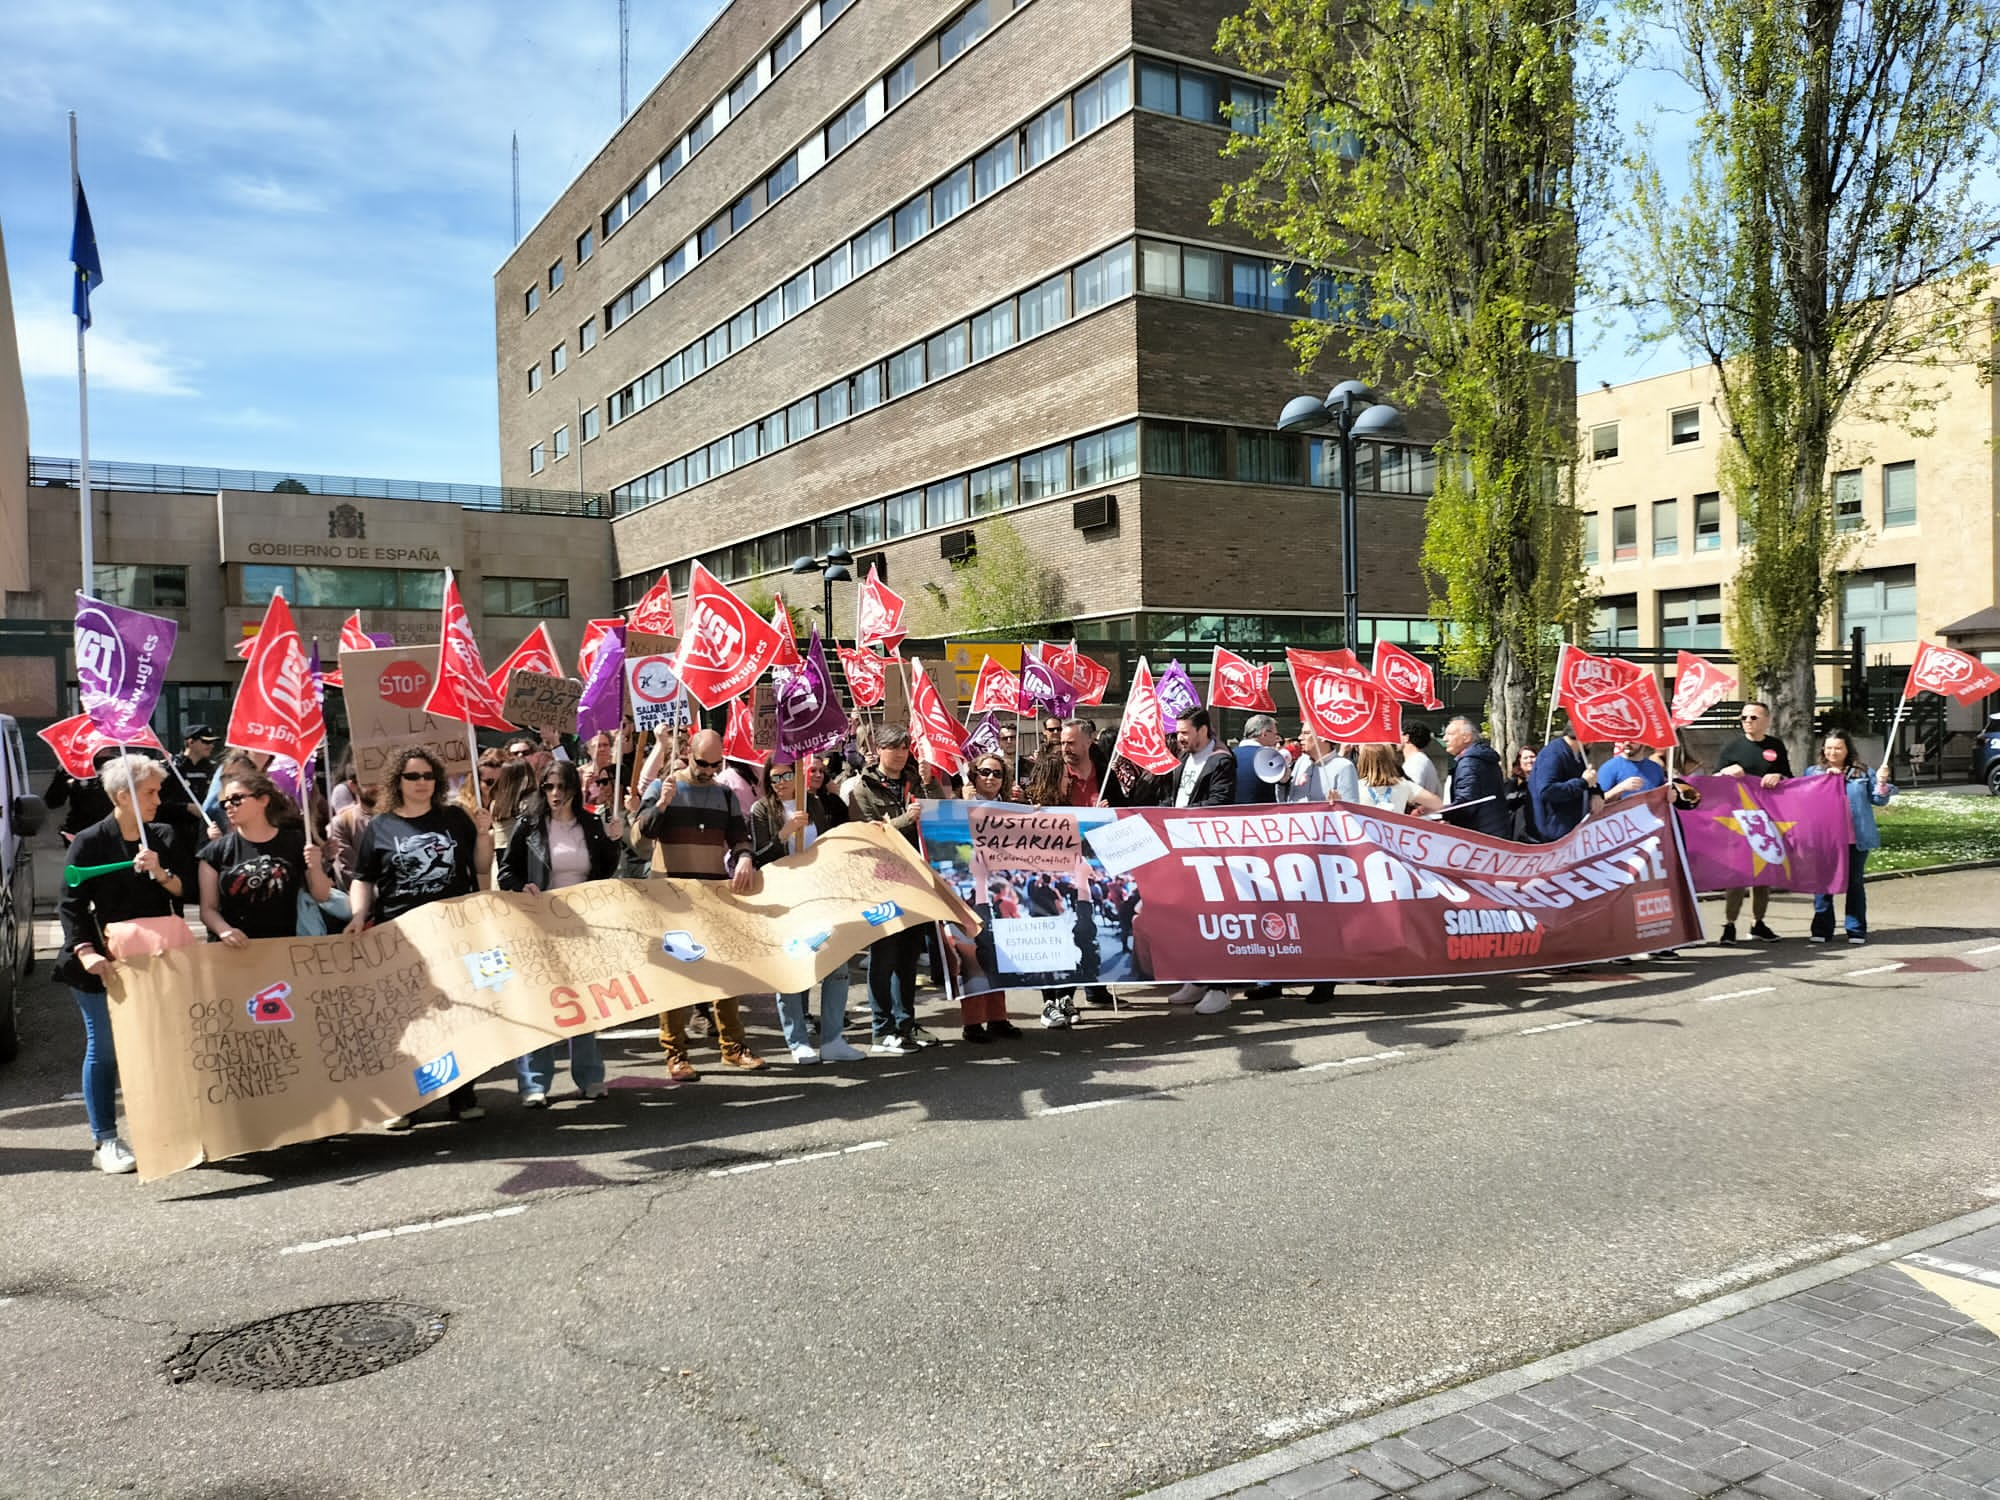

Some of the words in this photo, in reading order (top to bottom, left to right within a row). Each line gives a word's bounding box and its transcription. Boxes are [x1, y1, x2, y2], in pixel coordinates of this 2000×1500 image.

[248, 542, 342, 558] GOBIERNO
[346, 546, 369, 559] DE
[375, 547, 441, 562] ESPAÑA
[392, 623, 443, 633] GOBIERN
[690, 601, 742, 660] UGT
[709, 639, 768, 694] www.ugt.es
[380, 673, 428, 696] STOP
[1314, 677, 1364, 704] UGT
[670, 699, 689, 713] BJO
[370, 716, 388, 738] A
[407, 709, 438, 734] LA
[975, 815, 1071, 833] JUSTICIA
[975, 834, 1080, 850] SALARIAL
[1188, 814, 1434, 861] TRABAJADORES
[1447, 842, 1553, 875] CENTRO
[1181, 850, 1470, 904] TRABAJO
[1465, 835, 1668, 909] DECENTE
[1198, 913, 1257, 941] UGT
[1443, 909, 1524, 935] SALARIO
[1227, 943, 1267, 956] Castilla
[1267, 946, 1275, 958] y
[1276, 941, 1303, 955] León
[1446, 923, 1546, 960] CONFLICTO
[189, 998, 234, 1020] 060
[315, 999, 363, 1022] ALTAS
[234, 1028, 289, 1049] PREVIA
[192, 1043, 281, 1072] CONSULTA
[280, 1042, 303, 1061] DE
[207, 1081, 289, 1105] CANJES
